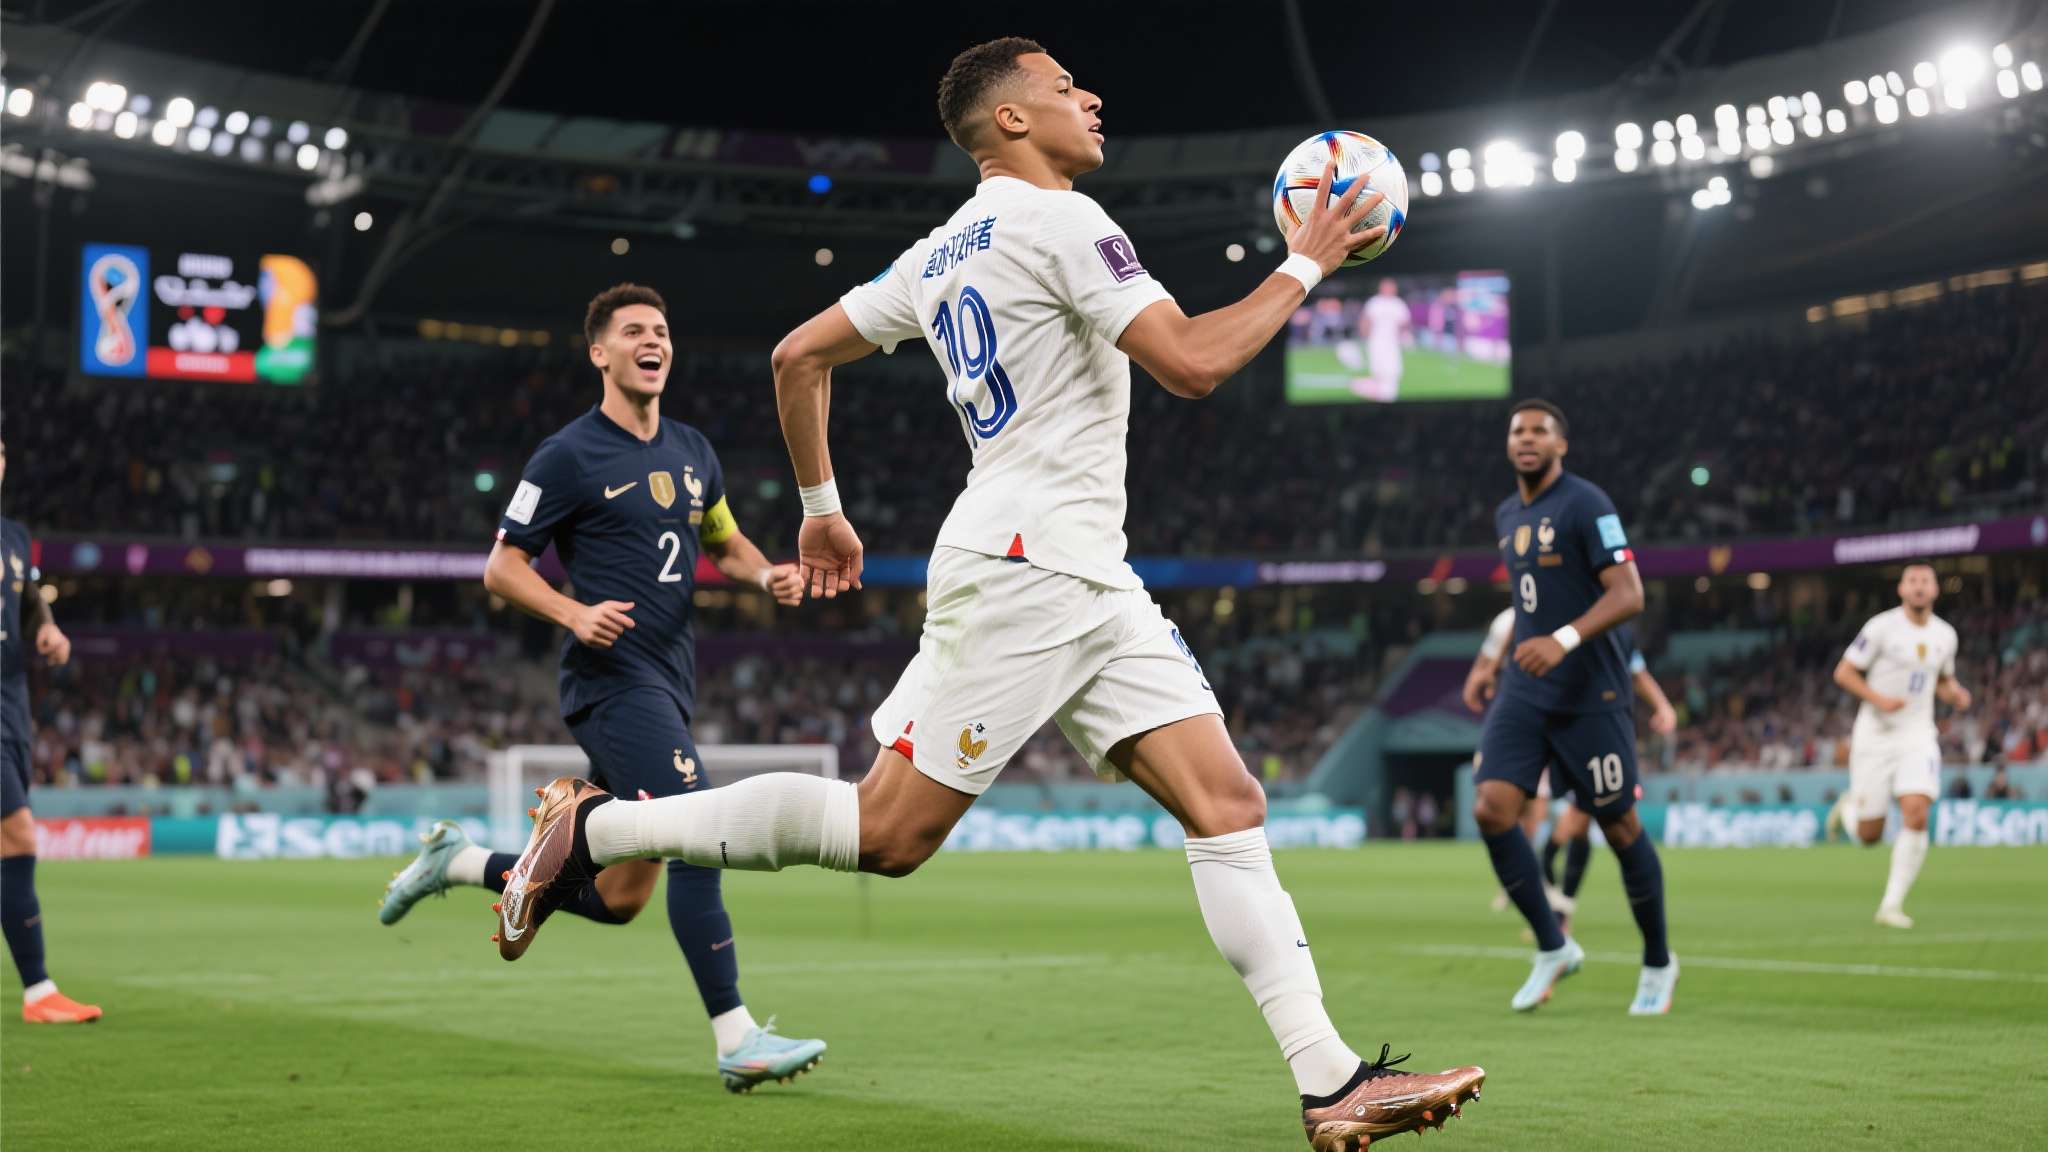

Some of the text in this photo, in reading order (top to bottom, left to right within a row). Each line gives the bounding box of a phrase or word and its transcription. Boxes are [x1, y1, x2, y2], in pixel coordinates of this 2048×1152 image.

[657, 531, 682, 583] 2
[1519, 573, 1538, 614] 9
[1586, 753, 1624, 795] 10
